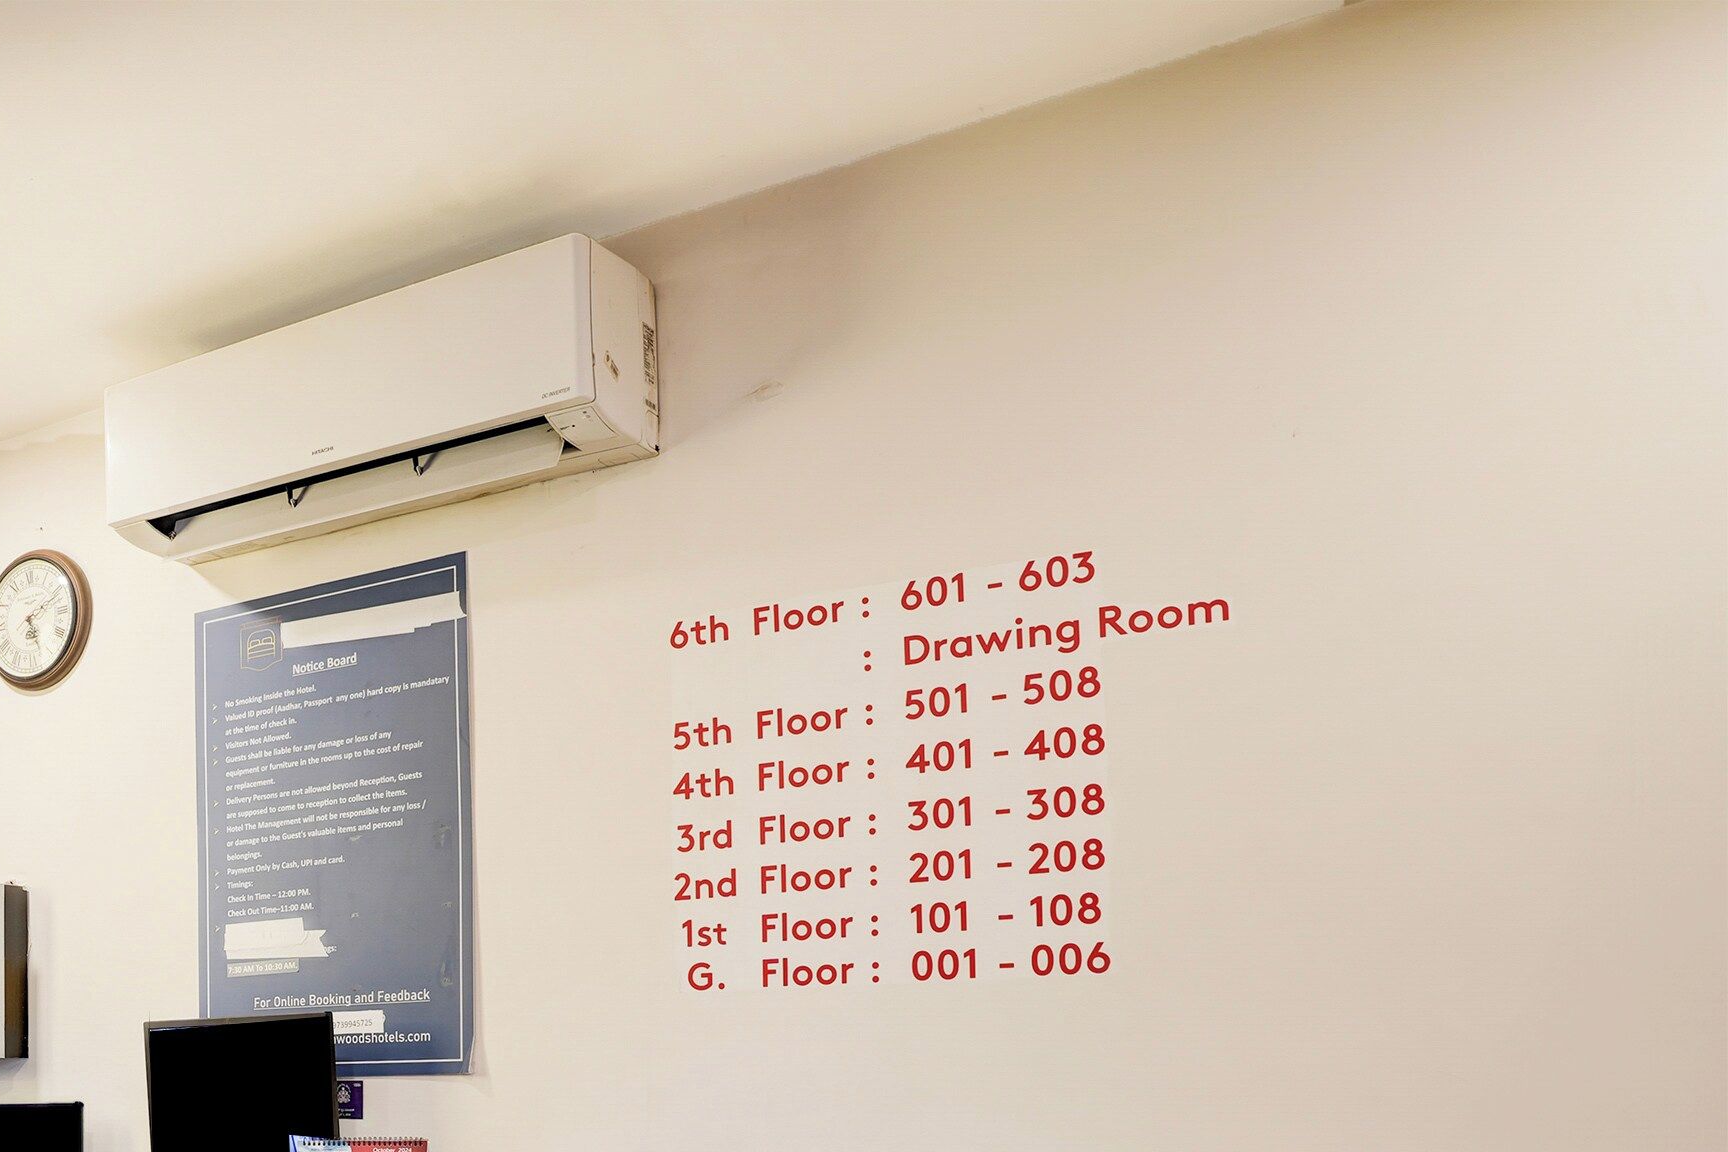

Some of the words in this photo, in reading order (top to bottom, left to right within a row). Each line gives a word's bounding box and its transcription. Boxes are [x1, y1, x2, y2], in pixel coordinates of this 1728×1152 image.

[670, 616, 730, 648] 6th
[753, 602, 844, 635] Floor
[901, 573, 965, 611] 601
[1018, 551, 1095, 592] 603
[903, 617, 1081, 666] Drawing
[1098, 598, 1230, 638] Room
[293, 661, 324, 674] Notice
[328, 652, 357, 667] Board
[235, 695, 262, 706] Smoking
[263, 691, 282, 700] Inside
[296, 685, 316, 694] Hotel.
[256, 707, 273, 717] proof
[304, 696, 332, 707] Passport
[336, 694, 348, 702] any
[350, 690, 365, 700] one)
[367, 687, 383, 697] hard
[384, 685, 401, 694] copy
[673, 718, 732, 750] 5th
[757, 709, 848, 739] Floor
[906, 684, 968, 720] 501
[1023, 666, 1102, 704] 508
[673, 768, 734, 800] 4th
[758, 760, 849, 791] Floor
[906, 739, 972, 773] 401
[1024, 724, 1105, 761] 408
[226, 796, 252, 805] Delivery
[253, 792, 278, 801] Persons
[304, 783, 331, 794] allowed
[333, 779, 358, 790] beyond
[360, 776, 397, 786] Reception,
[398, 771, 422, 781] Guests
[237, 806, 268, 818] supposed
[278, 804, 295, 812] come
[306, 798, 338, 809] reception
[348, 793, 371, 803] collect
[372, 791, 384, 799] the
[386, 789, 407, 798] items.
[677, 820, 733, 852] 3rd
[759, 815, 851, 845] Floor
[908, 796, 972, 831] 301
[1027, 783, 1105, 821] 308
[227, 866, 254, 875] Payment
[255, 863, 271, 872] Only
[272, 862, 280, 870] by
[281, 861, 300, 870] Cash,
[314, 857, 327, 865] and
[328, 855, 345, 863] card.
[674, 868, 737, 901] 2nd
[760, 863, 852, 895] Floor
[910, 849, 972, 883] 201
[1028, 838, 1105, 875] 208
[227, 881, 254, 889] Timings:
[228, 895, 246, 903] Check
[278, 890, 296, 898] 12:00
[228, 909, 246, 917] Check
[300, 903, 314, 911] AM.
[683, 919, 727, 948] 1st
[761, 912, 853, 943] Floor
[911, 902, 968, 934] 101
[1030, 891, 1102, 928] 108
[243, 965, 254, 973] AM
[687, 961, 726, 991] G.
[762, 958, 854, 988] Floor
[911, 949, 976, 981] 001
[1031, 941, 1111, 976] 006
[254, 997, 272, 1008] For
[273, 996, 306, 1007] Online
[309, 993, 351, 1007] Booking
[354, 991, 373, 1004] and
[377, 988, 430, 1002] Feedback
